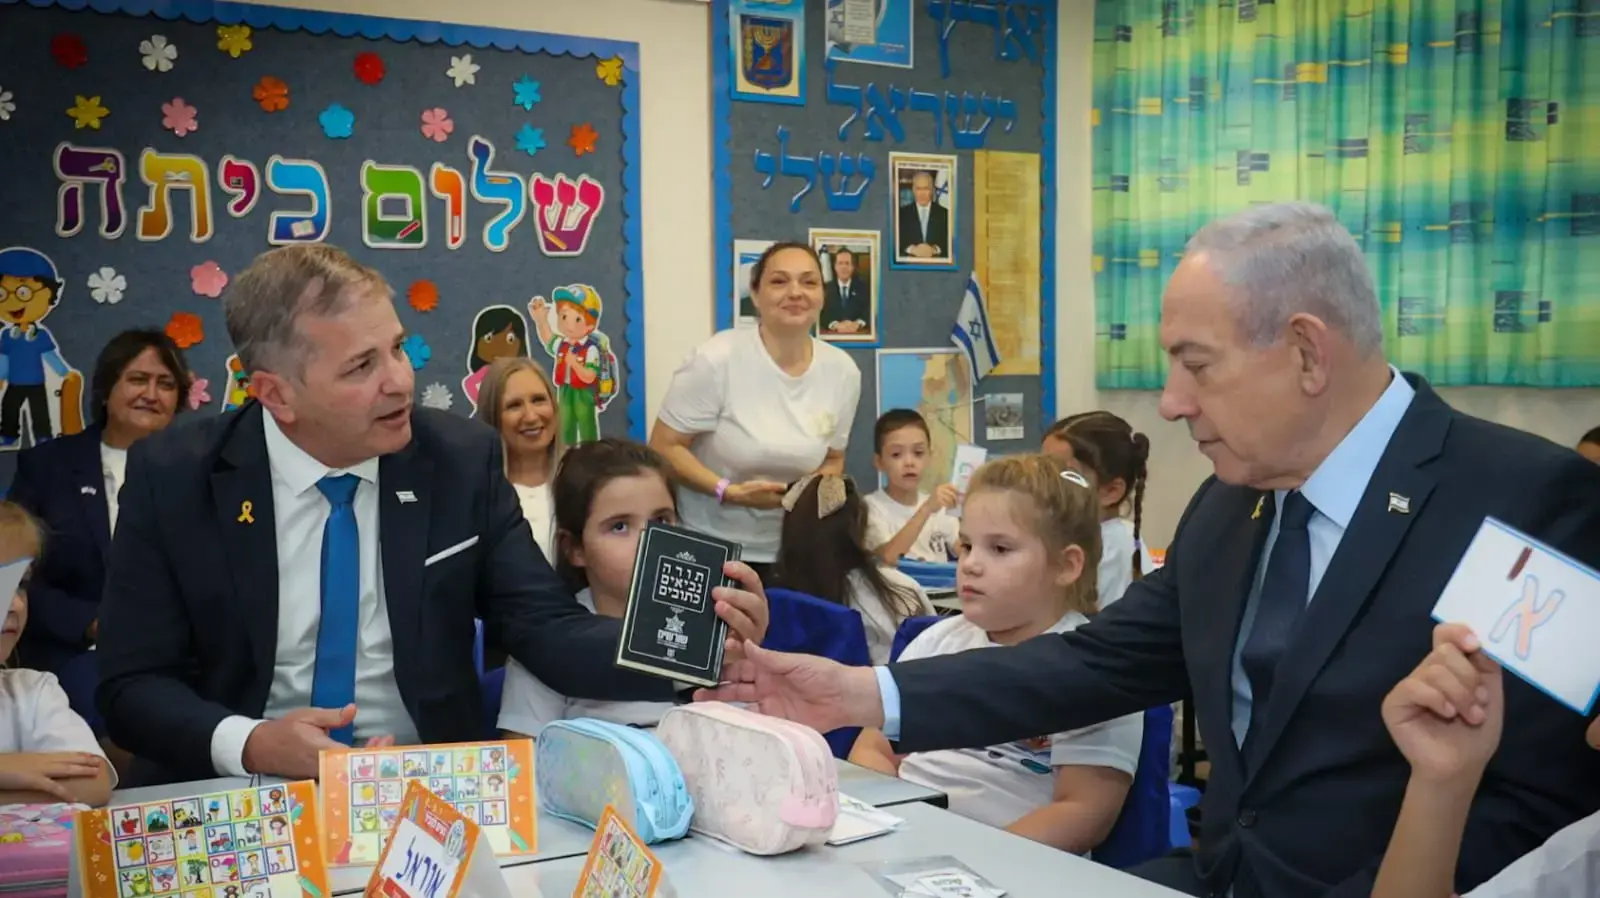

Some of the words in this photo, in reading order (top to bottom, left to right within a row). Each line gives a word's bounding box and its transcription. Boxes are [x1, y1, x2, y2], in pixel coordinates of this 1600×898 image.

[928, 0, 1041, 79] ארץ
[825, 56, 1018, 149] ישראל
[54, 142, 331, 245] כיתה
[361, 136, 603, 256] שלום
[754, 125, 876, 213] שלי
[658, 585, 701, 604] כתובים
[660, 574, 703, 594] נביאים
[662, 562, 704, 583] תורה
[396, 835, 447, 898] אוראל
